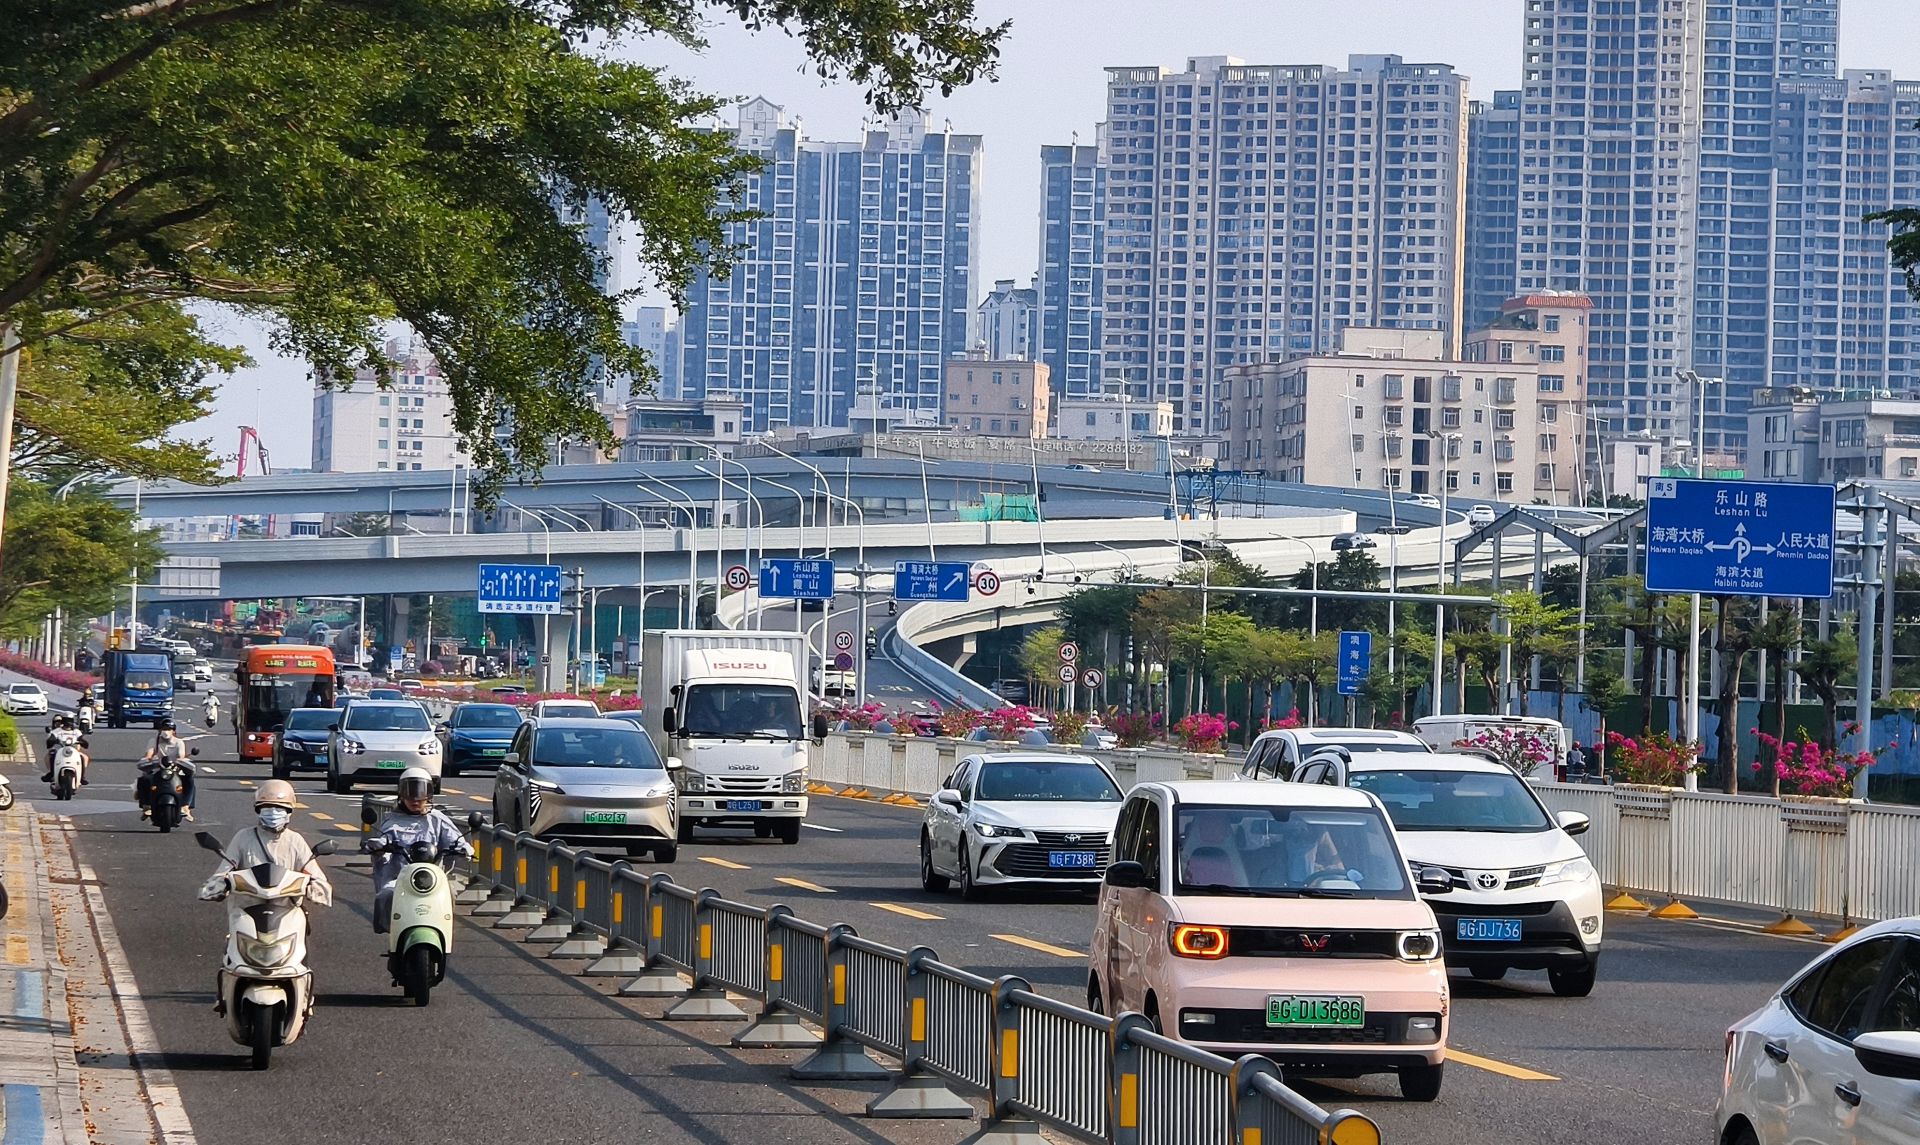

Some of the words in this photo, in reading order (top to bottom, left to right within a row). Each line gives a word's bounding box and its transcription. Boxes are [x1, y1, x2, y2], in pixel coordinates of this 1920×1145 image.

[1666, 483, 1673, 492] S
[1715, 489, 1768, 508] 乐山路
[1714, 506, 1750, 517] Leshan
[1755, 508, 1768, 517] Lu
[1651, 525, 1705, 545] 海湾大桥
[1776, 531, 1830, 550] 人民大道
[1650, 545, 1676, 554] Haiwan
[1679, 546, 1704, 556] Daqiao
[1776, 550, 1804, 559] Renmin
[1807, 551, 1829, 560] Dadao
[793, 561, 820, 573] 乐山路
[911, 564, 939, 576] 海湾大桥
[1715, 565, 1764, 579] 海滨大道
[730, 572, 746, 585] 50
[980, 577, 996, 590] 30
[1714, 578, 1738, 588] Haibin
[1741, 579, 1764, 588] Dadao
[838, 635, 850, 646] 30
[713, 662, 768, 670] ISUZU
